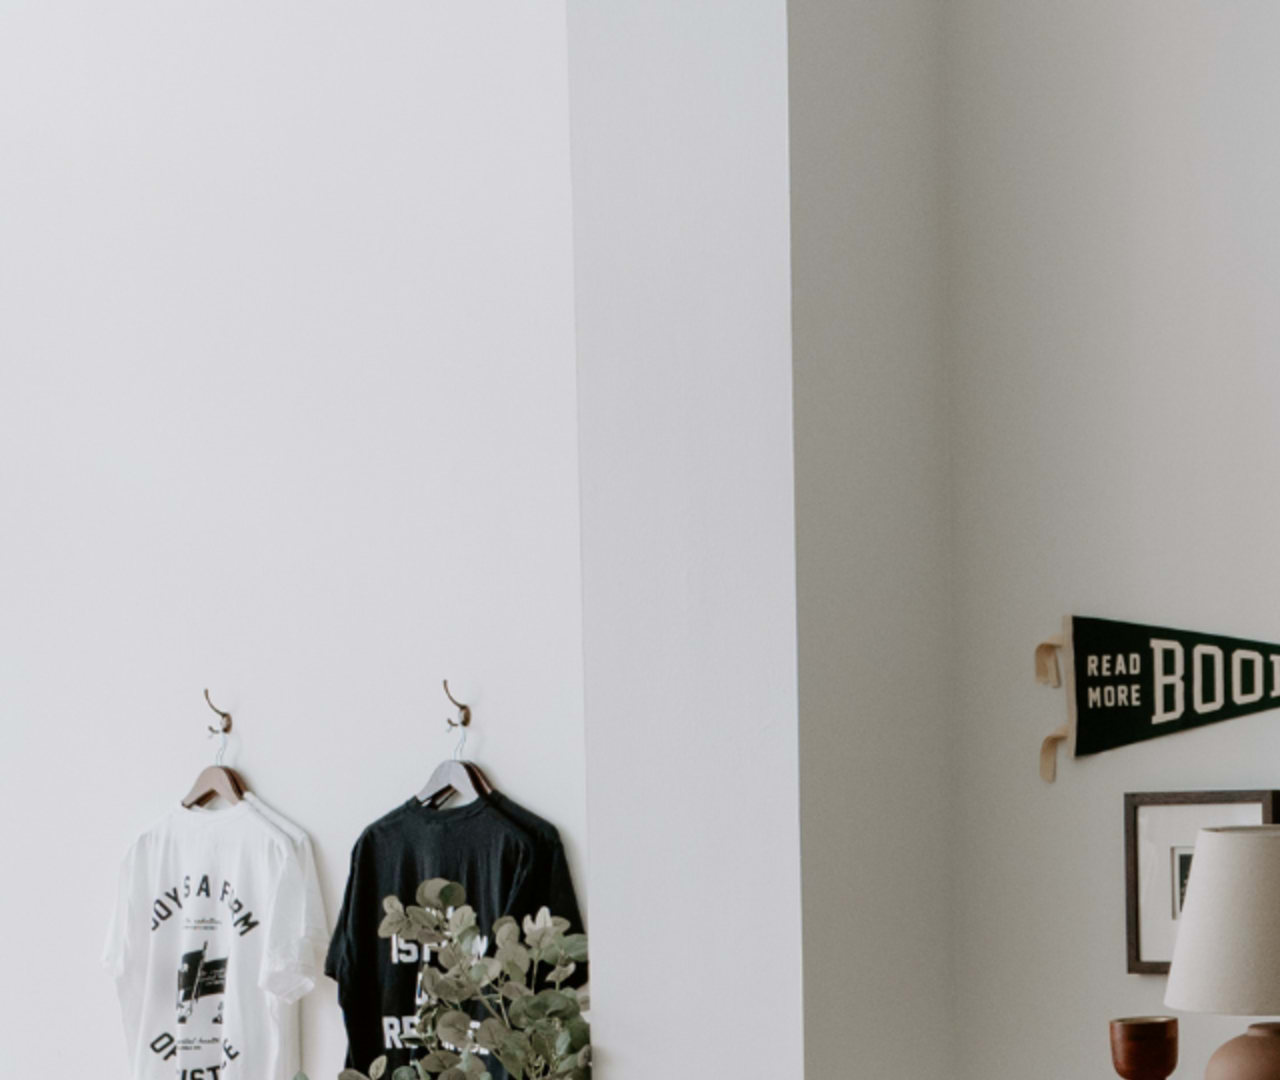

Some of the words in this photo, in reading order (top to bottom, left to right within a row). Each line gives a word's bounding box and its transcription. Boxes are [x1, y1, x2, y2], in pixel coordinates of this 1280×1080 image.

[1087, 653, 1142, 677] READ
[1088, 684, 1142, 708] MORE
[196, 874, 211, 898] A
